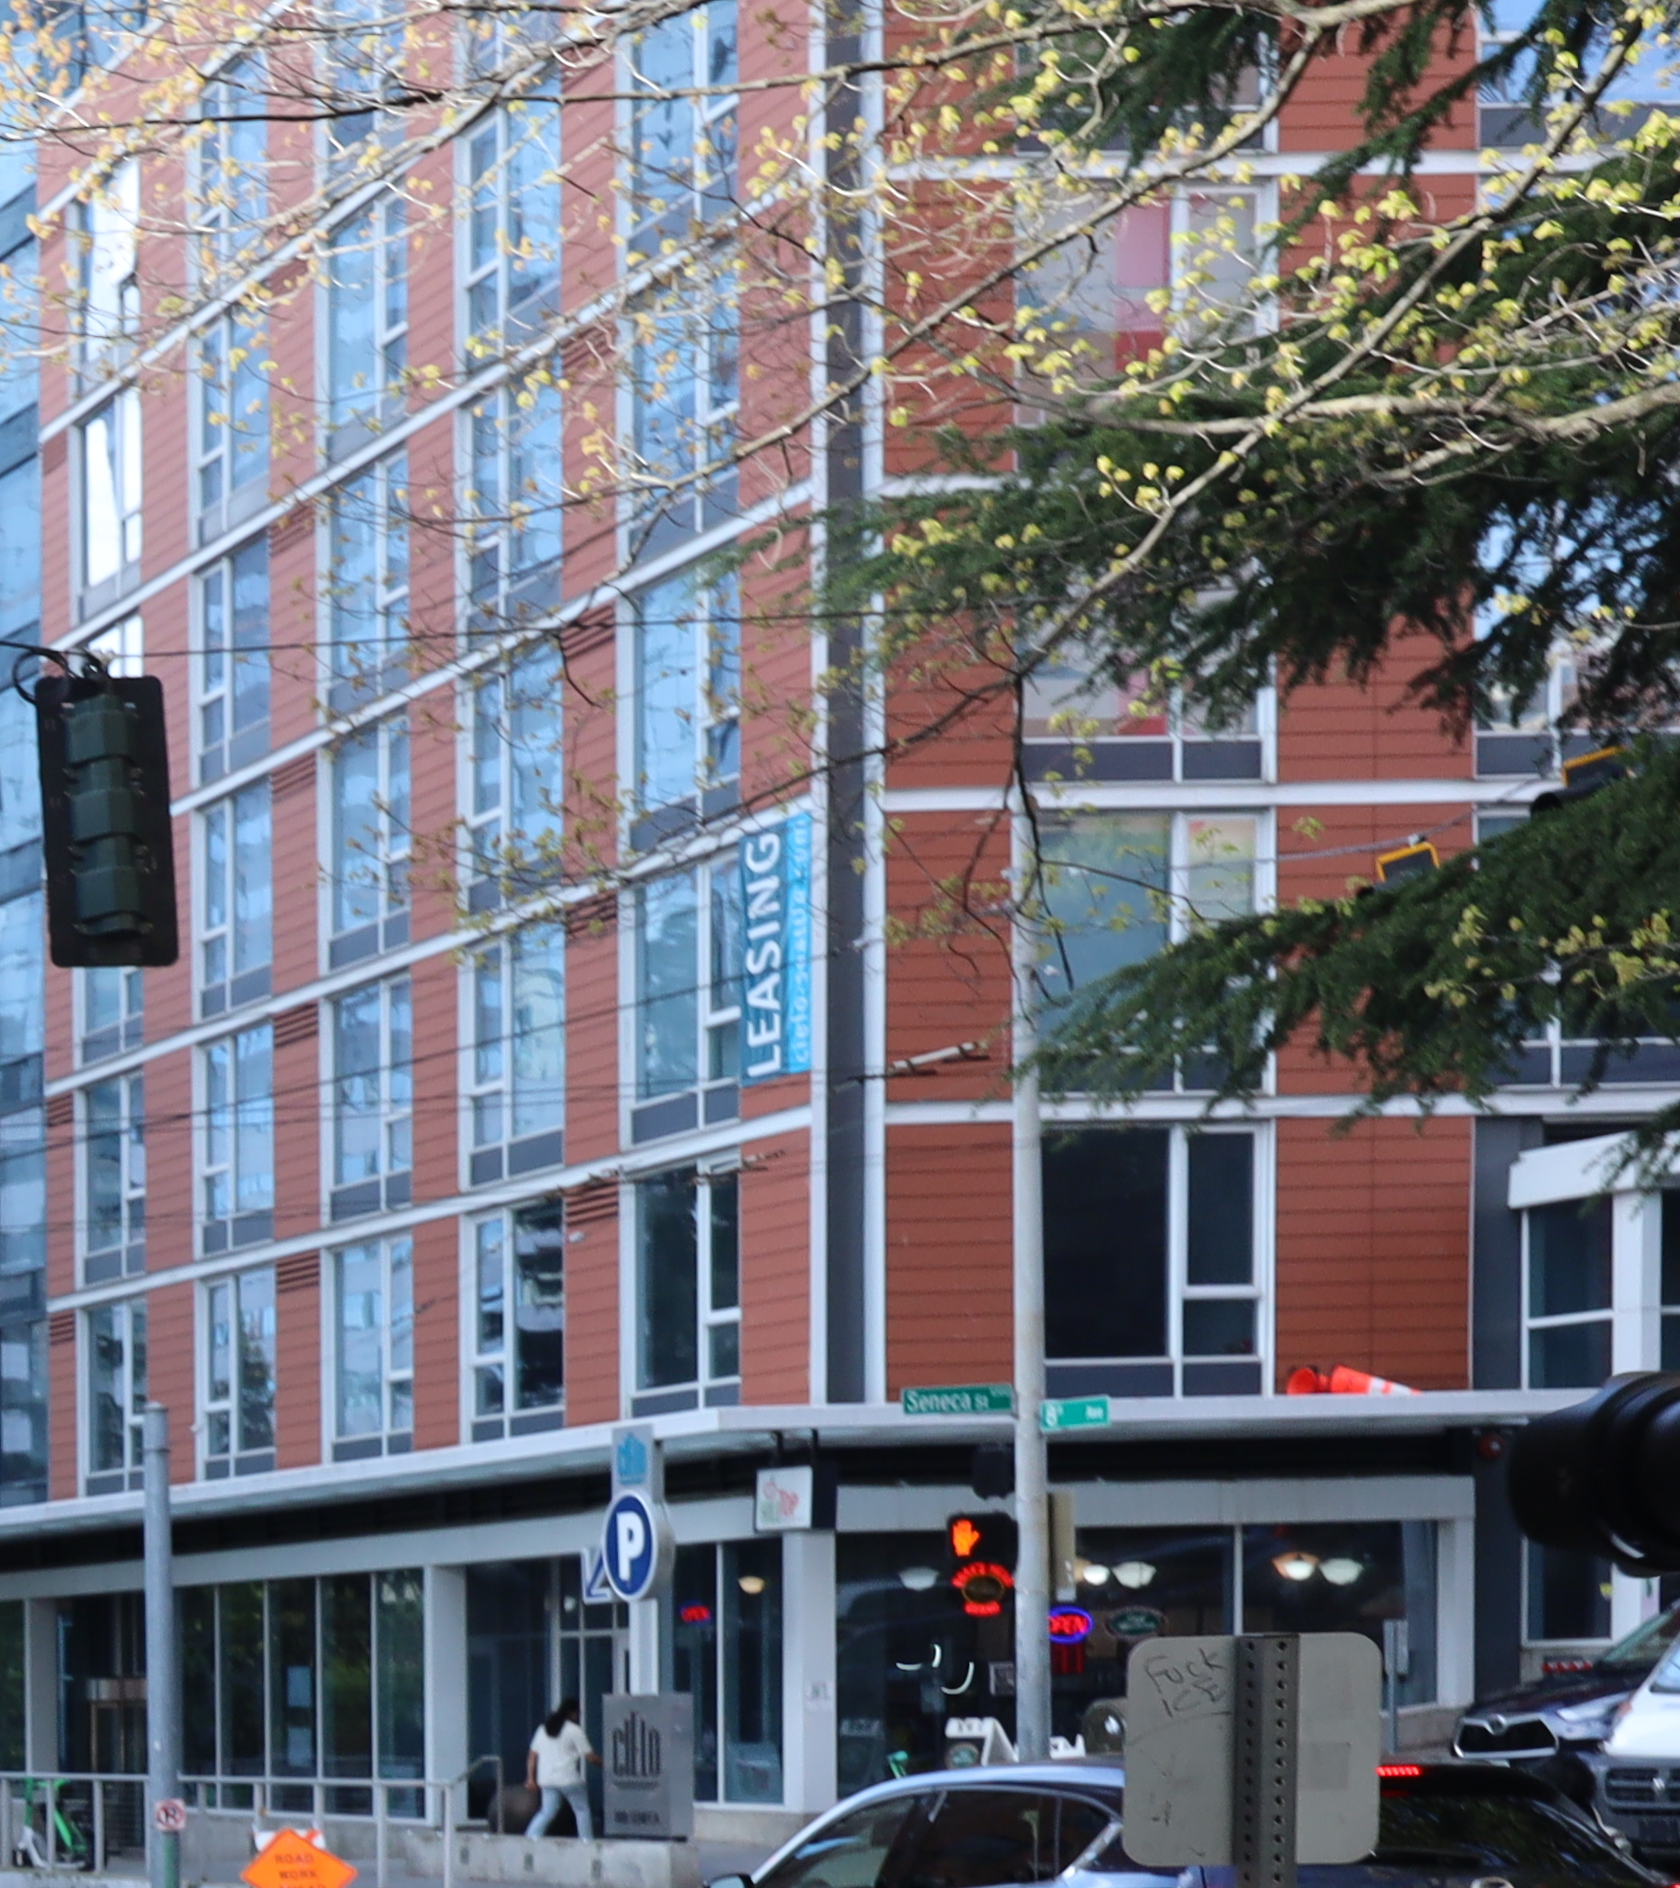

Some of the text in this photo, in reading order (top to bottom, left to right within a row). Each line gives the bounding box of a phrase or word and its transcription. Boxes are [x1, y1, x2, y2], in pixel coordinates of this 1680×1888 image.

[745, 832, 781, 1077] LEASING
[906, 1390, 972, 1413] Seneca
[616, 1510, 645, 1582] P
[1143, 1648, 1227, 1694] Fuck
